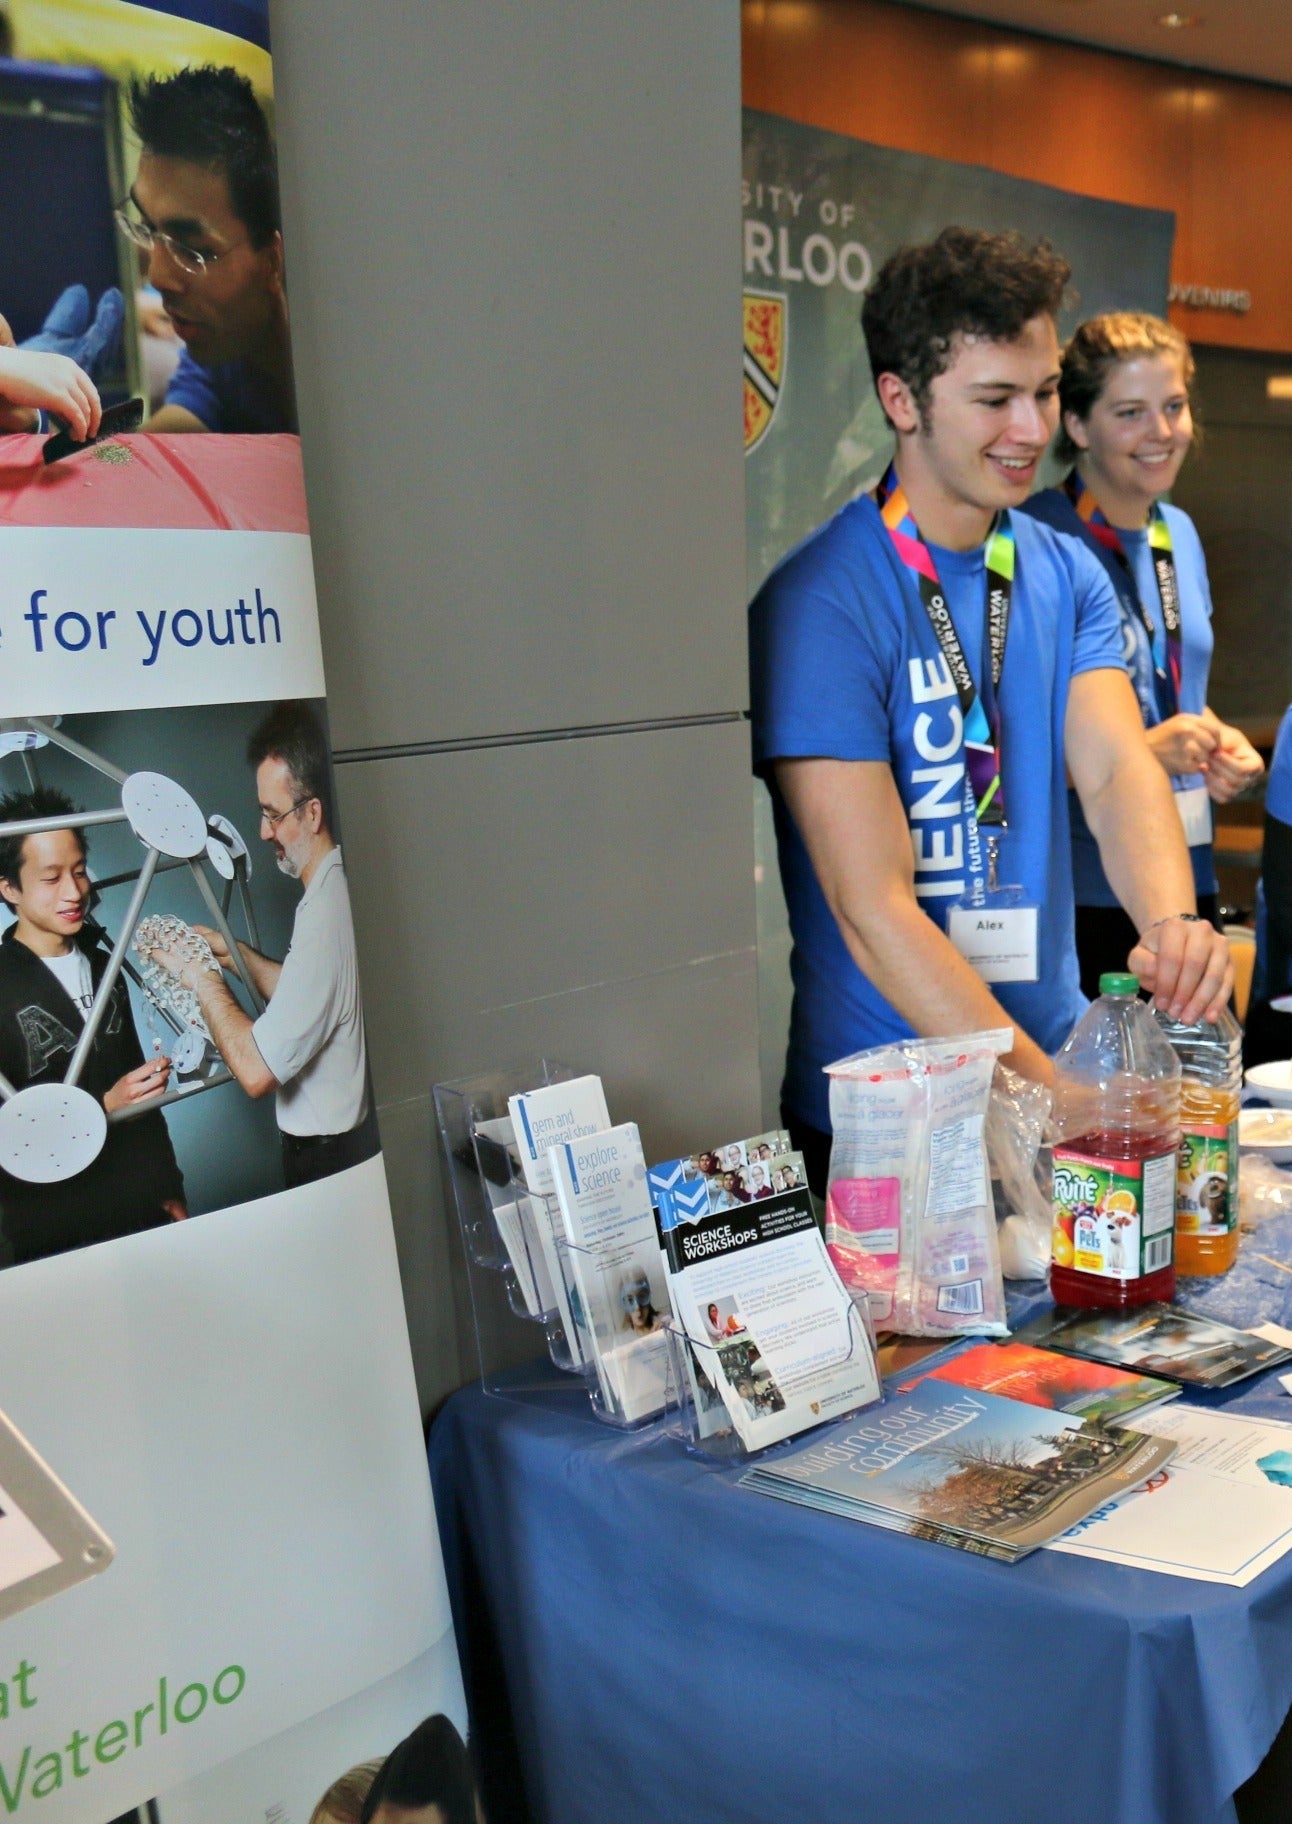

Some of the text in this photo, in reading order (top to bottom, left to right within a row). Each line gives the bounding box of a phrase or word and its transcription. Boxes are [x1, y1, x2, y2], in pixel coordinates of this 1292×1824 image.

[819, 199, 856, 228] OF
[744, 219, 873, 293] RLOO
[24, 588, 281, 666] for youth
[988, 589, 1004, 684] WATERLOO
[930, 594, 972, 691] WATERLOO
[966, 817, 982, 872] future
[970, 878, 986, 907] the
[976, 920, 1004, 931] Alex
[532, 1110, 575, 1137] gem and
[536, 1128, 573, 1152] mineral
[578, 1145, 619, 1173] explore
[582, 1166, 622, 1193] science
[683, 1224, 731, 1249] SCIENCE
[684, 1229, 758, 1260] WORKSHOPS
[776, 1405, 927, 1479] building our
[850, 1394, 988, 1476] community
